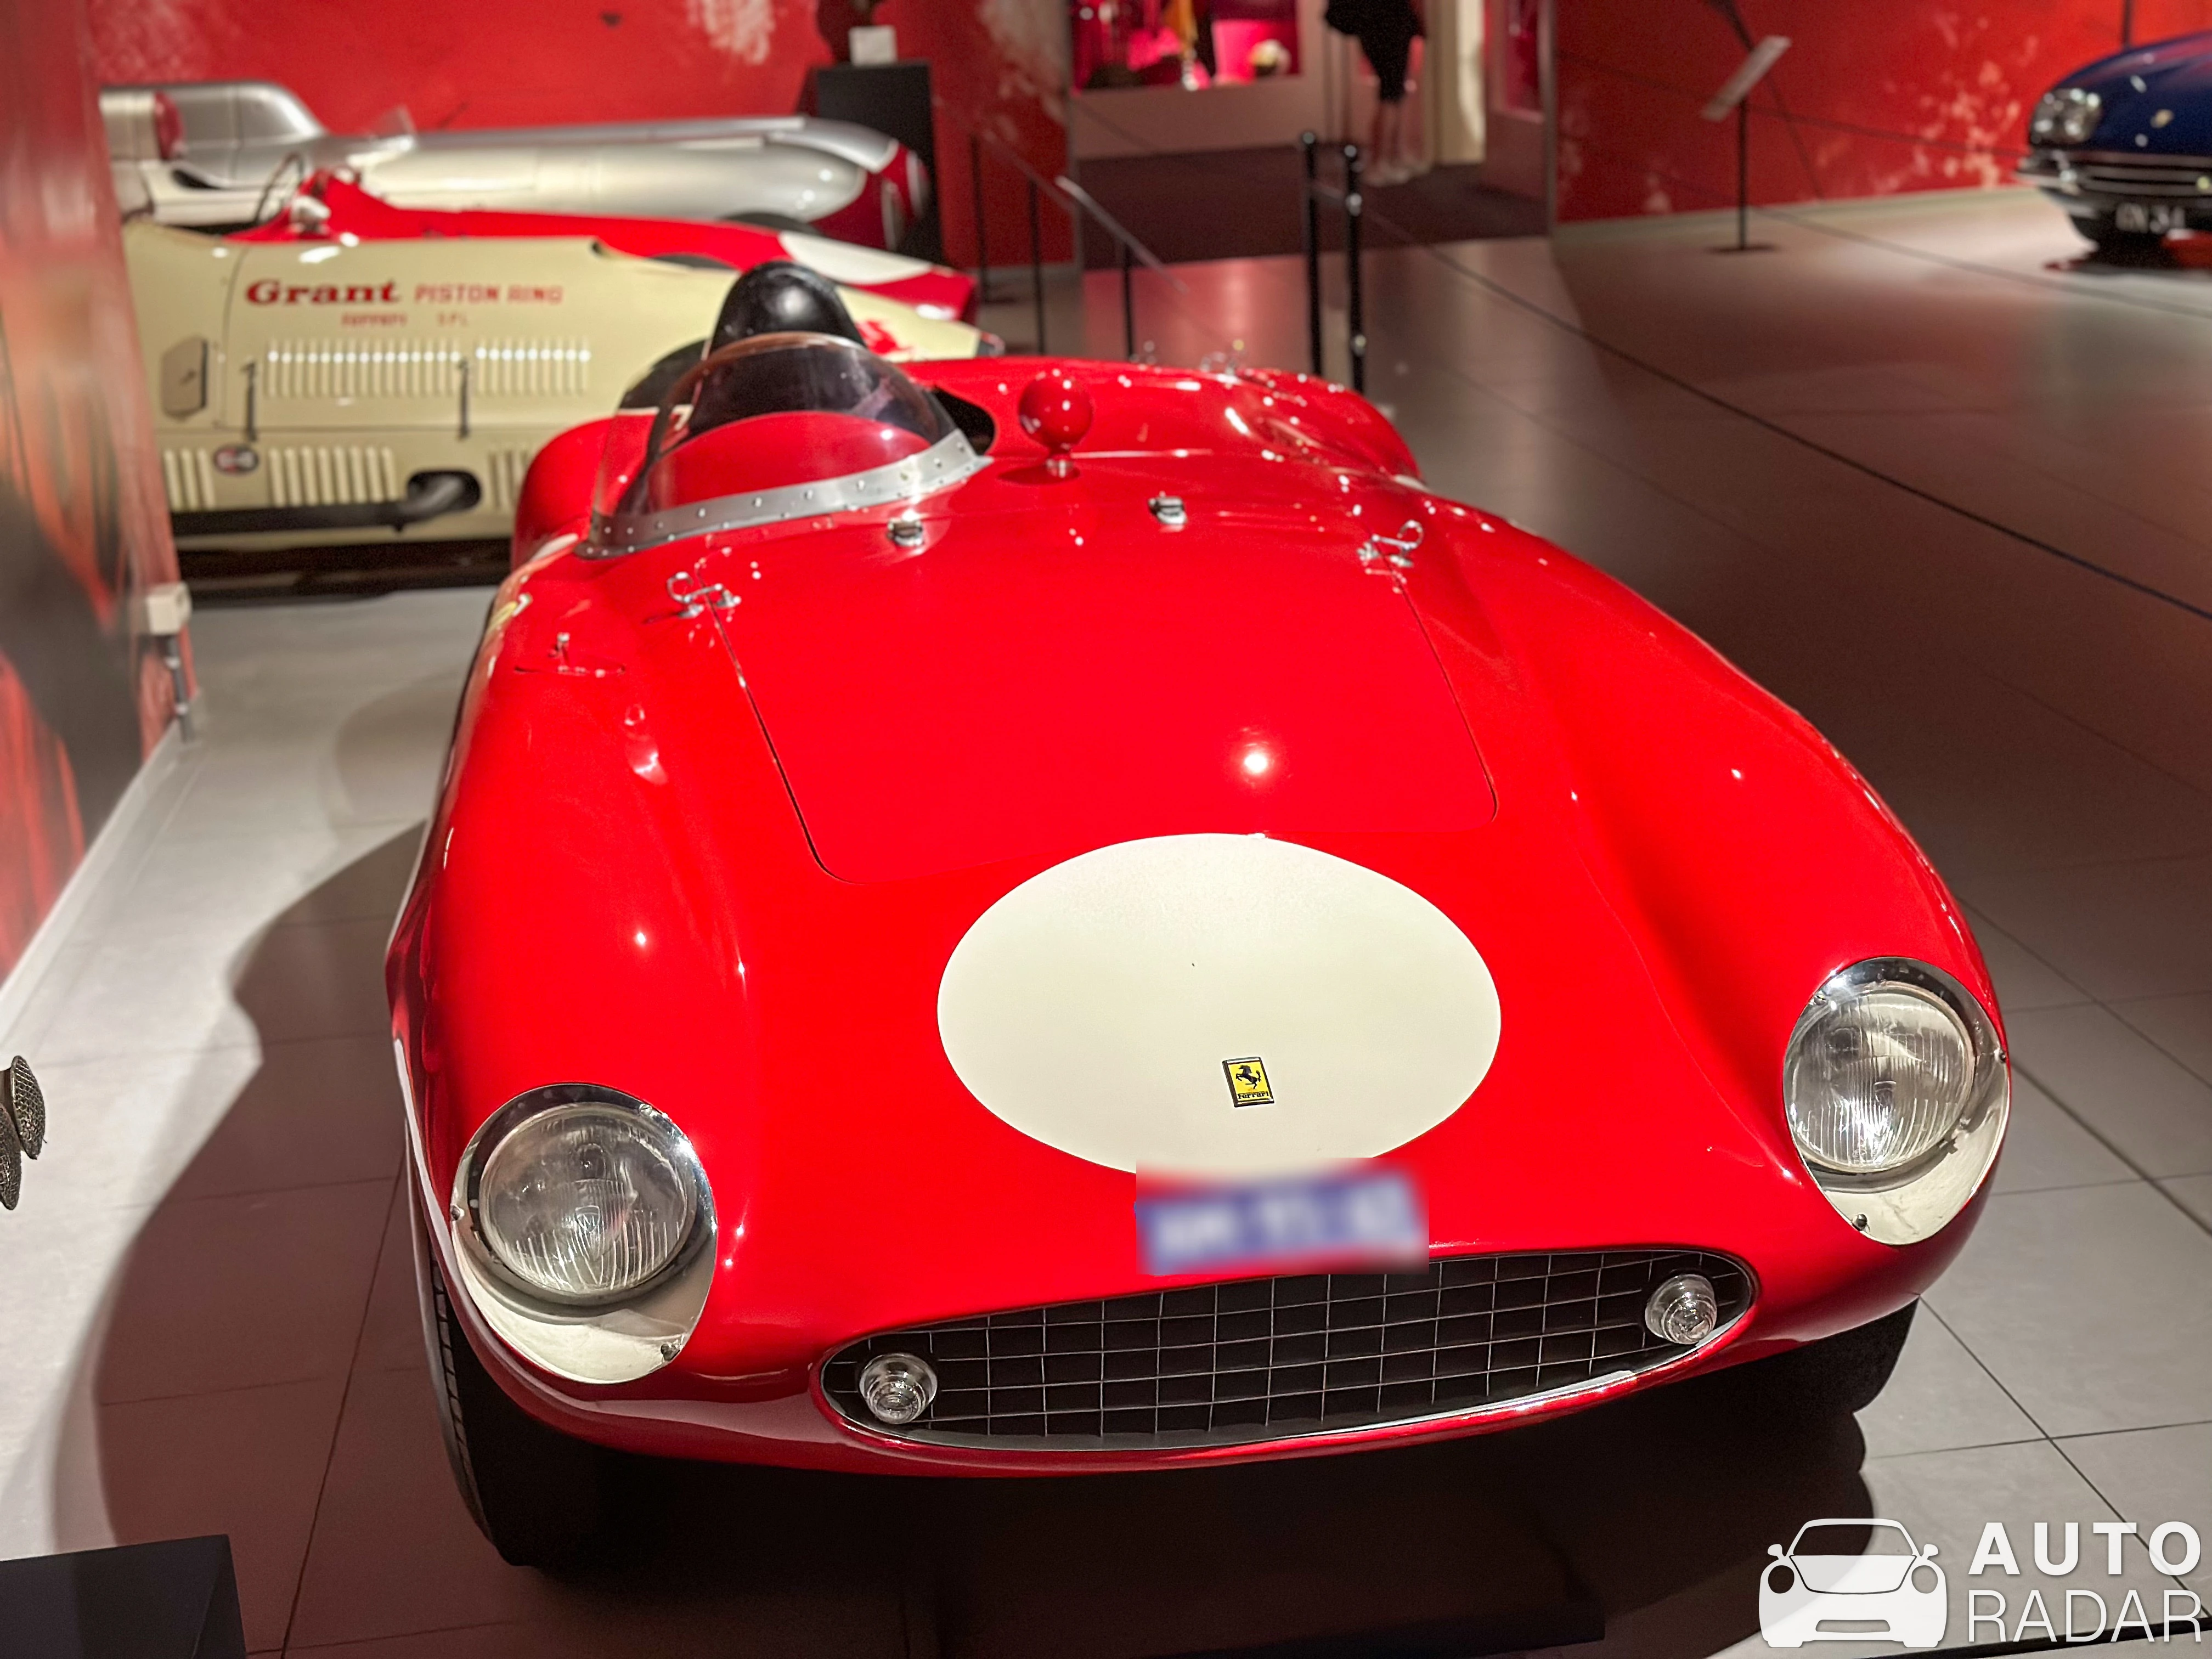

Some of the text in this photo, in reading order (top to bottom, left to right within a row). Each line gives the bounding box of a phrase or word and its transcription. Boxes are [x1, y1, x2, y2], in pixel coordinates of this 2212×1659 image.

[245, 279, 399, 306] Grant
[414, 284, 501, 304] PISTON
[1237, 1091, 1269, 1099] Ferrari
